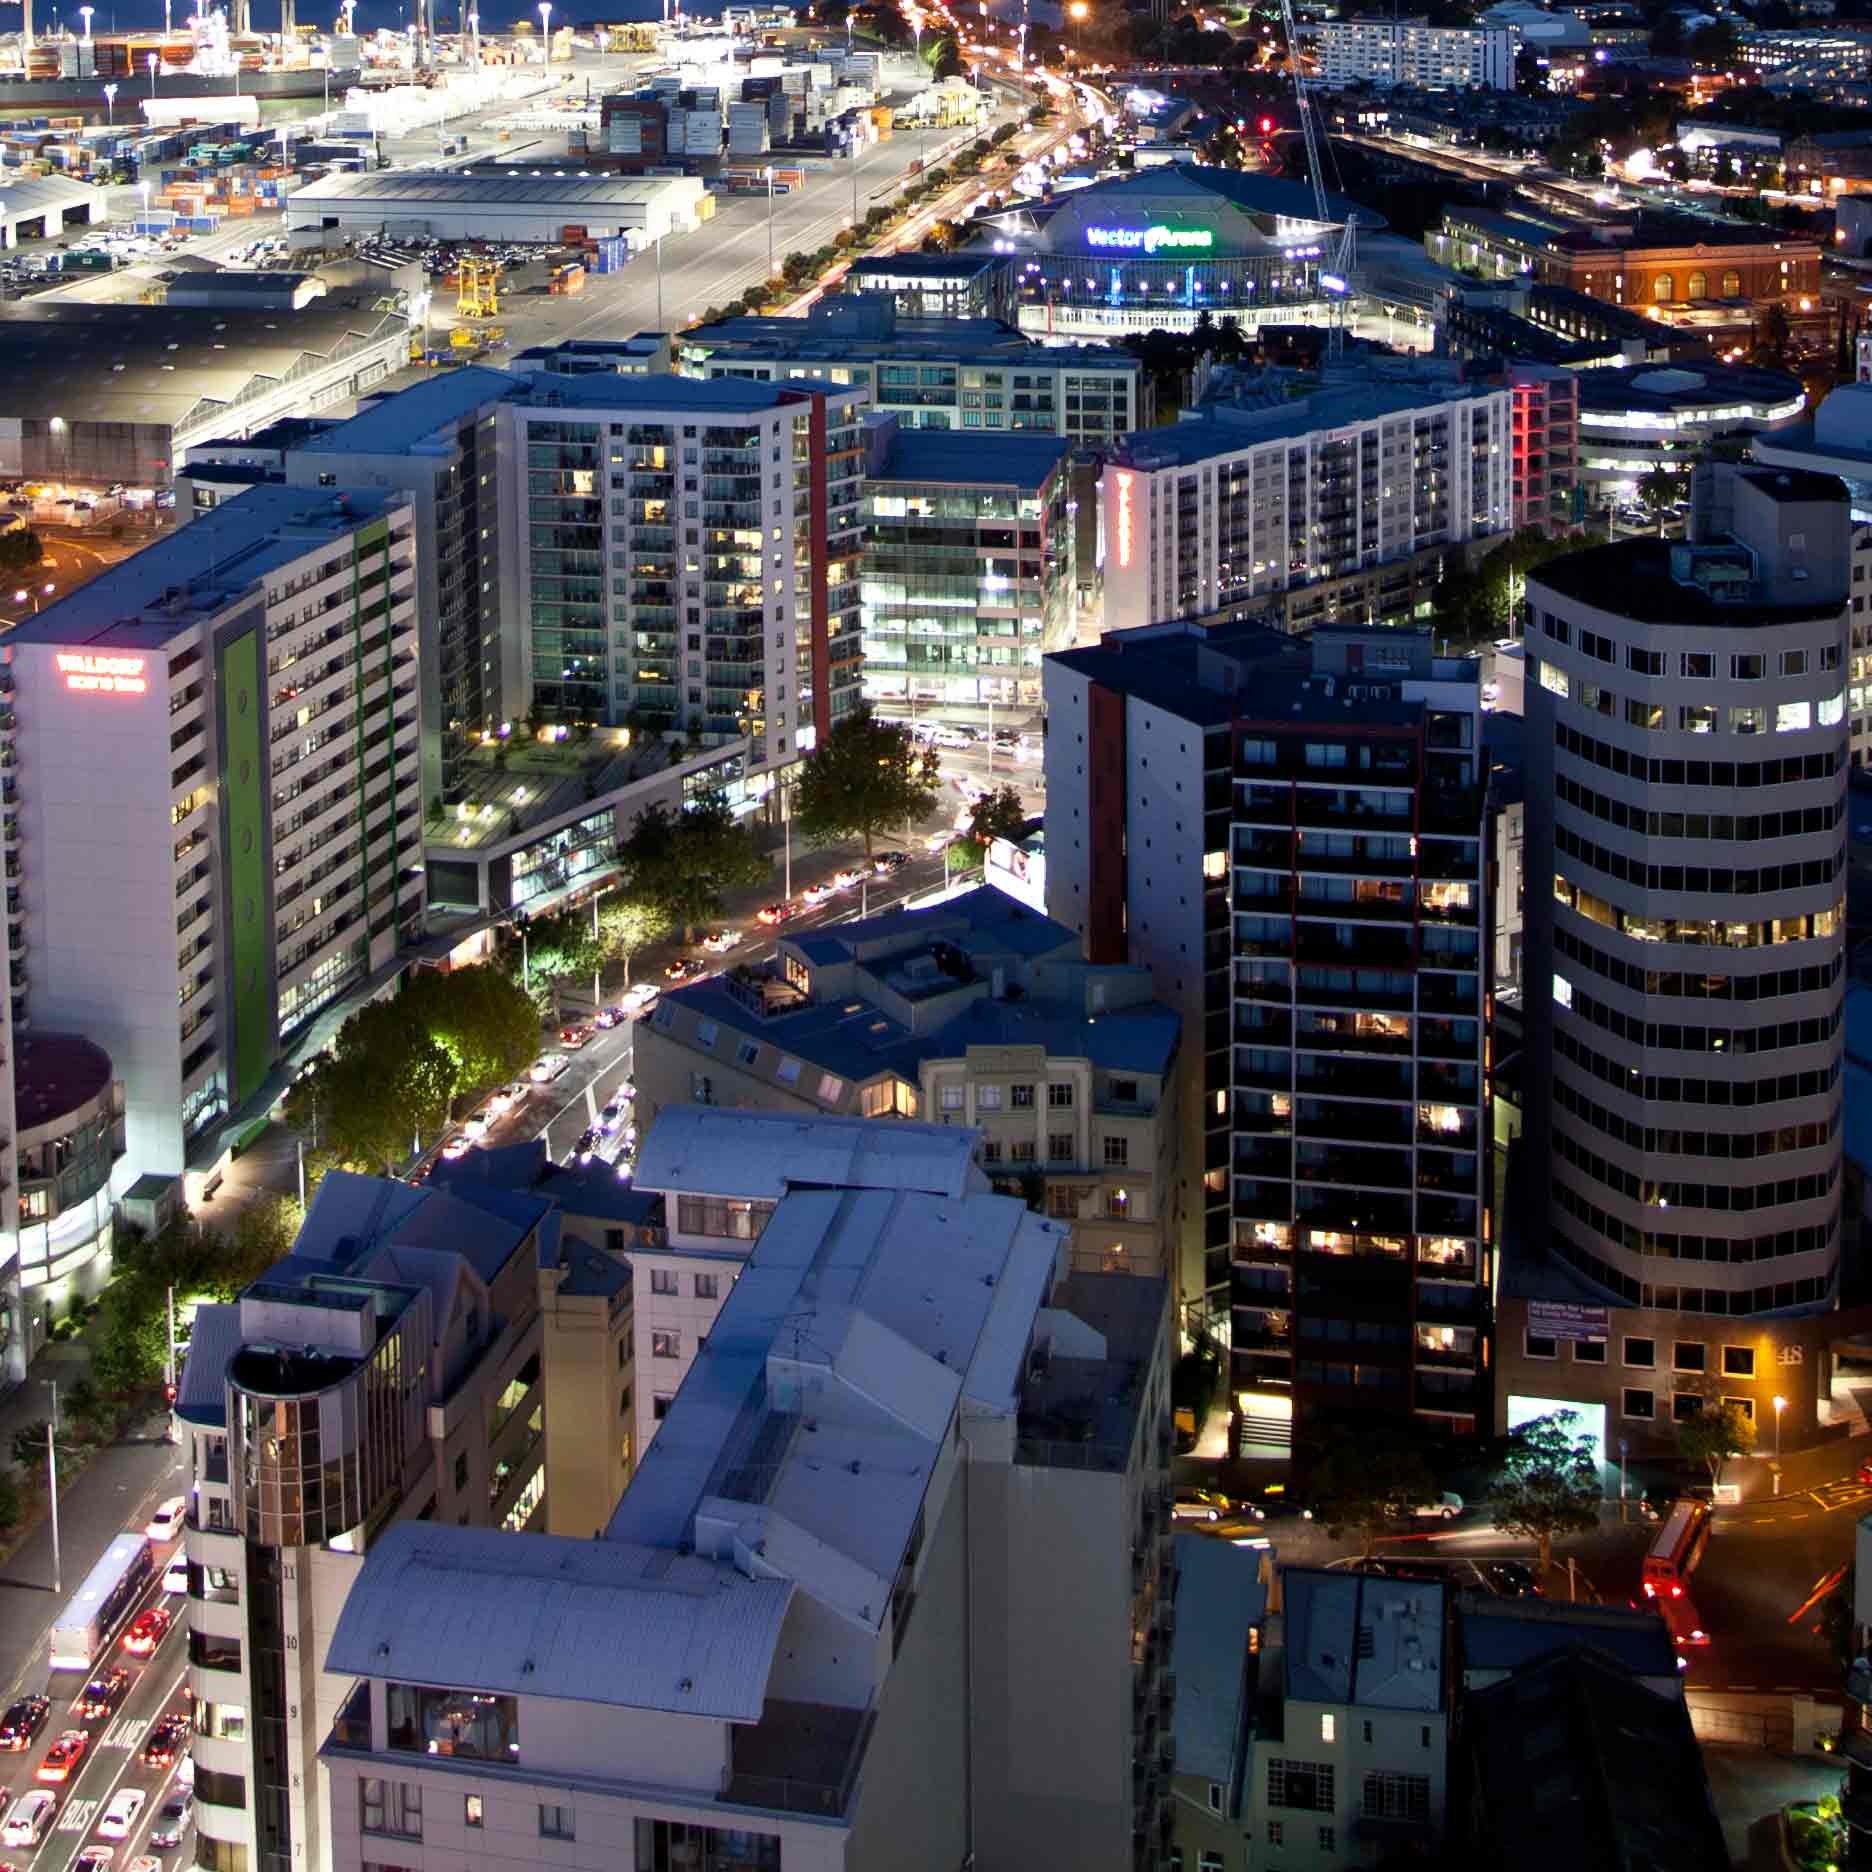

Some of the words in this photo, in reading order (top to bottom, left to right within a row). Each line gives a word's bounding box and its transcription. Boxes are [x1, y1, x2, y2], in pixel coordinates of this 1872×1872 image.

[1087, 227, 1143, 247] Vector
[1157, 230, 1212, 247] Arena
[283, 1565, 296, 1580] 11
[285, 1634, 298, 1650] 10
[290, 1704, 298, 1718] 9
[101, 1719, 148, 1747] LANE
[58, 1800, 98, 1830] BUS
